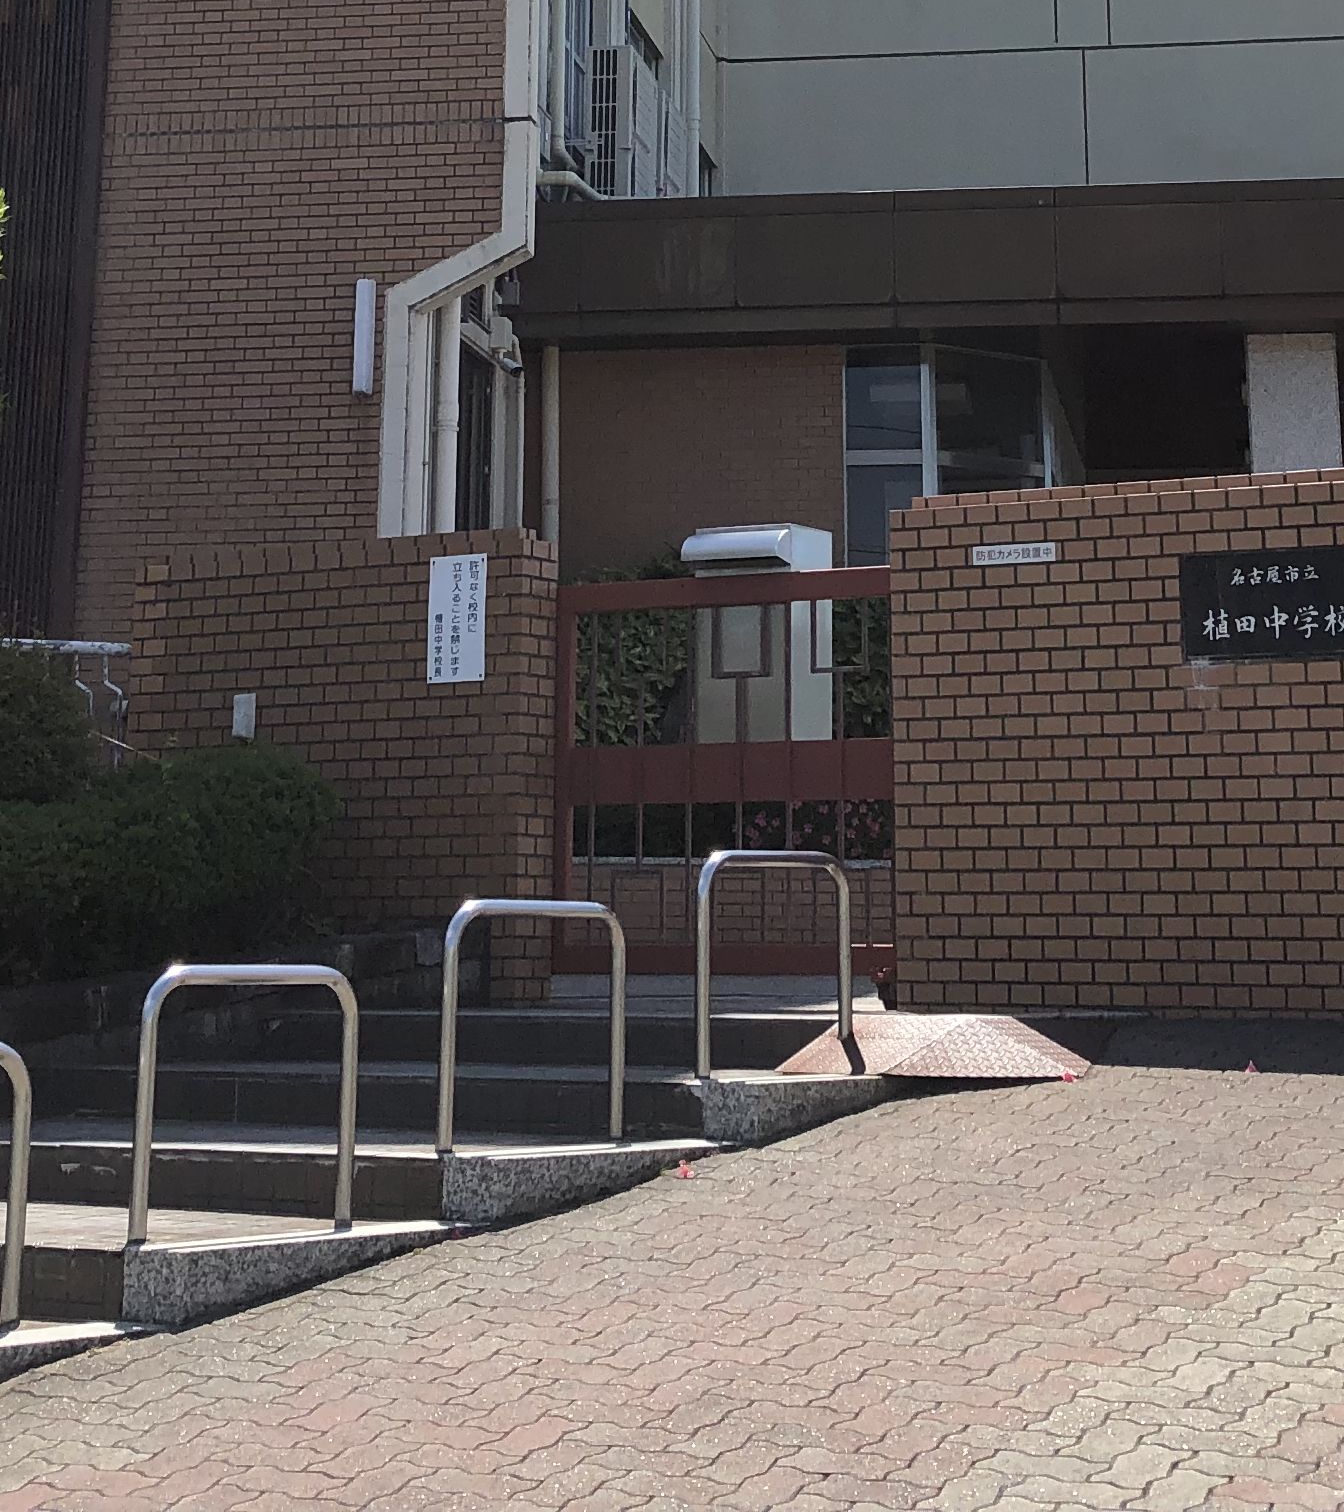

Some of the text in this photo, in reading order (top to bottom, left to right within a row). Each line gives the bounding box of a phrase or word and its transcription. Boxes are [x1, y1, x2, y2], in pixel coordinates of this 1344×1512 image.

[975, 547, 1052, 561] 防犯カメラ設置中
[1230, 564, 1320, 586] 名古屋市立
[450, 562, 463, 676] 立ち入ることを禁じます
[467, 560, 479, 633] 許可なく校内に
